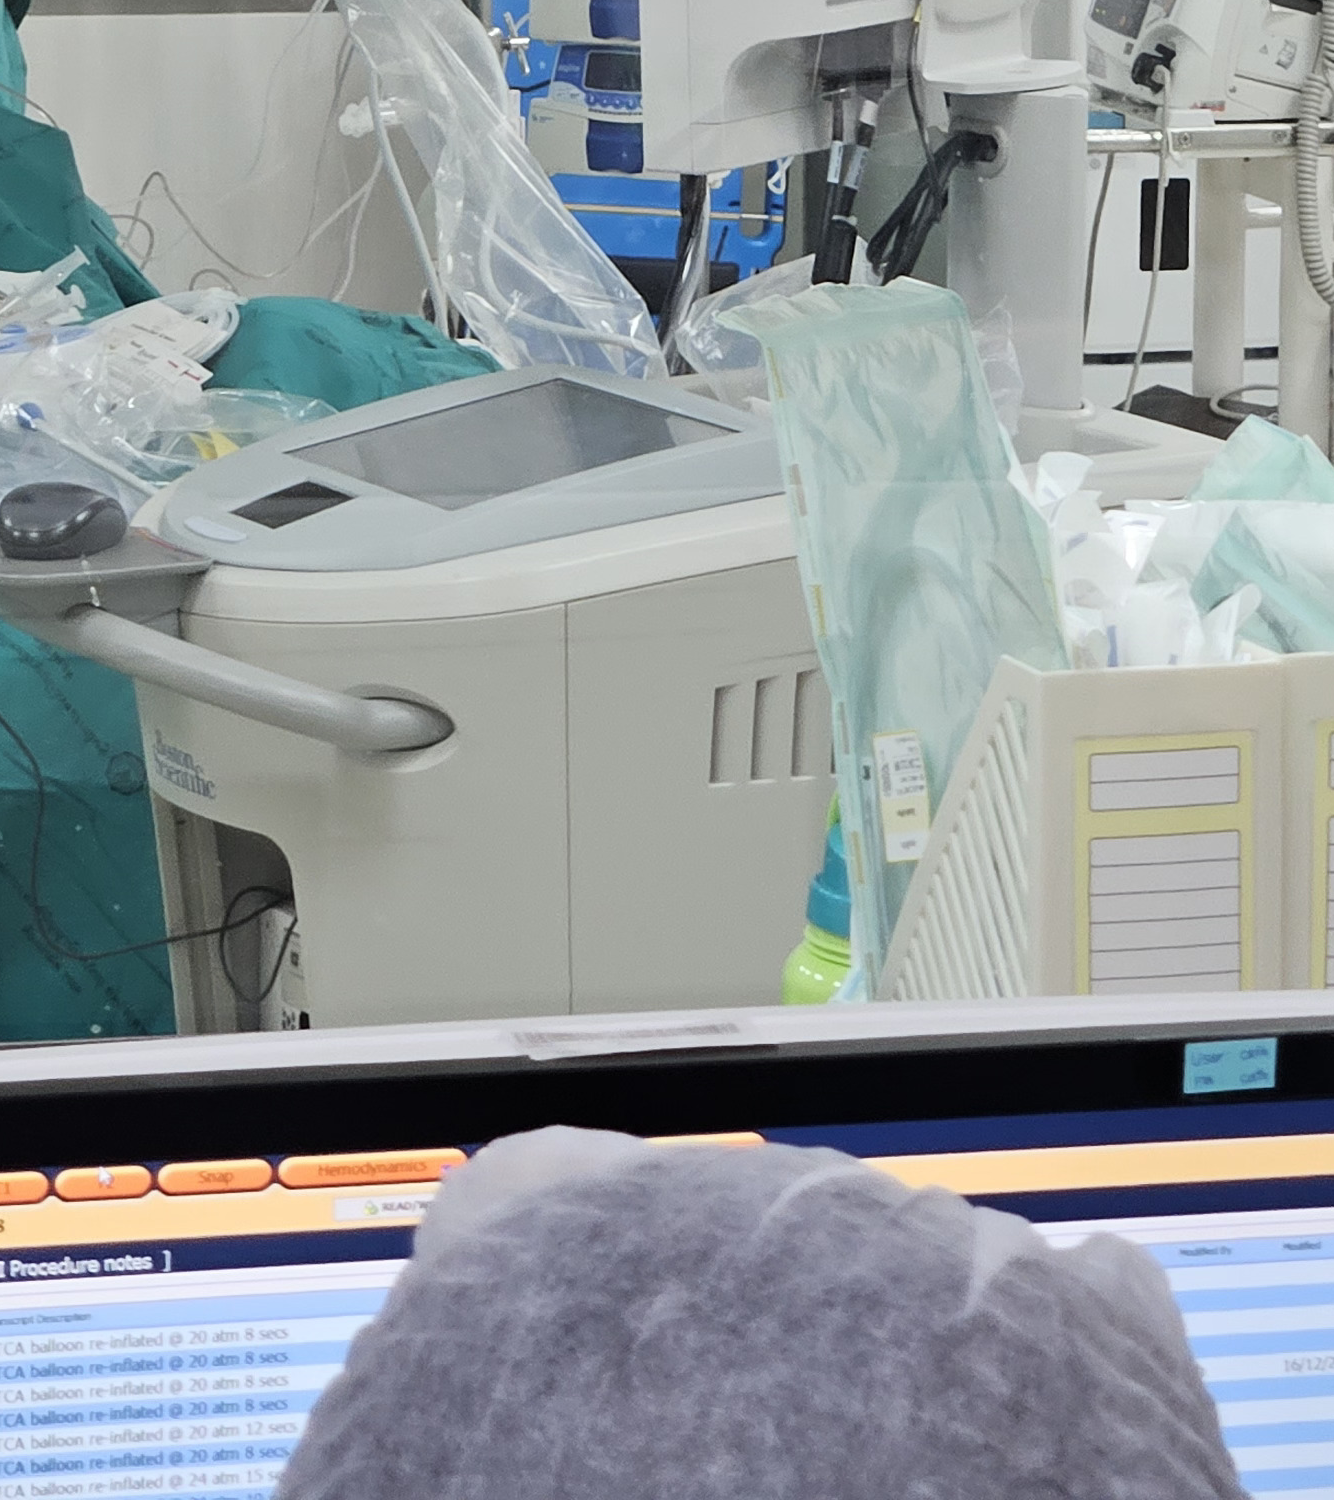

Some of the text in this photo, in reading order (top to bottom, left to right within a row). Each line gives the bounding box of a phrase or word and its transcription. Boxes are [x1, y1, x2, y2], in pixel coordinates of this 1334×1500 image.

[197, 1170, 235, 1186] Snap
[317, 1160, 427, 1178] Hemodynamics
[9, 1256, 101, 1278] Procedure
[103, 1255, 153, 1272] notes
[30, 1338, 84, 1354] balloon
[89, 1332, 164, 1351] re-inflated
[189, 1330, 208, 1345] 20
[212, 1329, 240, 1343] atm
[244, 1328, 254, 1341] 8
[259, 1328, 289, 1340] secs
[30, 1362, 84, 1378] balloon
[89, 1356, 164, 1375] re-inflated
[189, 1354, 208, 1369] 20
[212, 1353, 240, 1367] atm
[244, 1352, 254, 1365] 8
[259, 1352, 289, 1364] secs
[30, 1386, 84, 1402] balloon
[89, 1380, 164, 1399] re-inflated
[189, 1377, 208, 1392] 20
[212, 1376, 240, 1390] atm
[244, 1375, 254, 1388] 8
[259, 1375, 289, 1387] secs
[30, 1410, 84, 1426] balloon
[89, 1404, 164, 1423] re-inflated
[189, 1401, 208, 1416] 20
[212, 1400, 240, 1414] atm
[244, 1399, 254, 1412] 8
[259, 1399, 289, 1411] secs
[30, 1434, 84, 1450] balloon
[89, 1428, 164, 1447] re-inflated
[189, 1425, 208, 1440] 20
[212, 1424, 240, 1438] atm
[246, 1422, 264, 1436] 12
[268, 1422, 297, 1434] secs
[30, 1458, 84, 1474] balloon
[89, 1452, 164, 1471] re-inflated
[189, 1448, 208, 1464] 20
[212, 1448, 240, 1462] atm
[244, 1446, 254, 1460] 8
[259, 1446, 289, 1458] secs
[30, 1482, 84, 1498] balloon
[89, 1476, 164, 1495] re-inflated
[189, 1472, 208, 1487] 24
[212, 1471, 240, 1485] atm
[246, 1469, 264, 1483] 15
